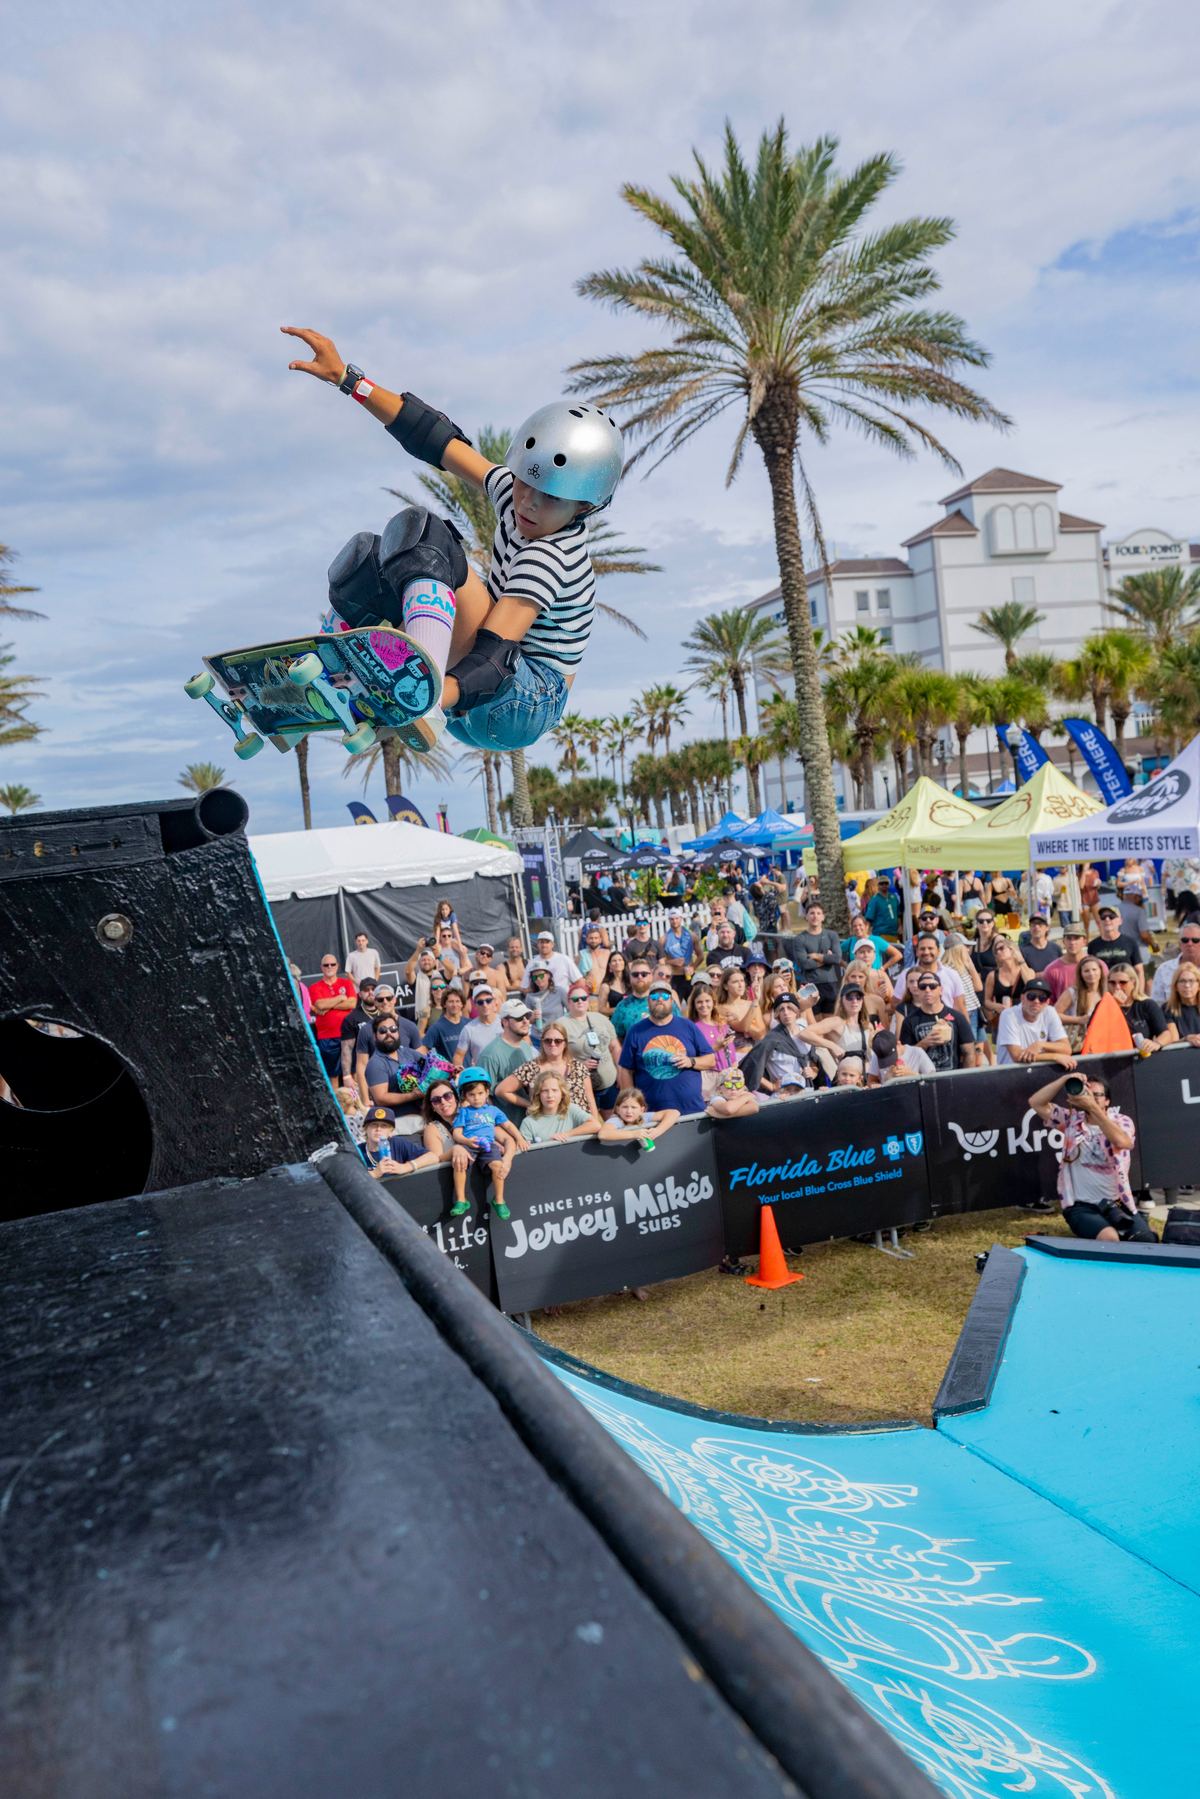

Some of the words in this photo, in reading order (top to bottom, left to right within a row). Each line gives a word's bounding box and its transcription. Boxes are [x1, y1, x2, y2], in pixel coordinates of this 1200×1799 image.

[416, 593, 455, 617] CAN
[1080, 728, 1111, 771] HERE
[1102, 769, 1126, 801] TER
[1036, 839, 1069, 854] WHERE
[1072, 838, 1090, 852] THE
[1092, 837, 1115, 851] TIDE
[1117, 836, 1154, 851] MEETS
[1156, 835, 1192, 851] STYLE
[1007, 1107, 1065, 1164] Kro
[728, 1153, 824, 1191] Florida
[826, 1144, 877, 1172] Blue
[758, 1194, 780, 1205] Your
[781, 1189, 803, 1201] local
[804, 1185, 826, 1196] Blue
[827, 1181, 853, 1191] Cross
[853, 1175, 874, 1186] Blue
[874, 1167, 903, 1183] Shield
[504, 1206, 619, 1259] Jersey
[624, 1170, 714, 1225] Mike's
[529, 1199, 574, 1217] SINCE
[578, 1191, 612, 1207] 1956
[432, 1215, 488, 1254] life
[639, 1214, 682, 1235] SUBS
